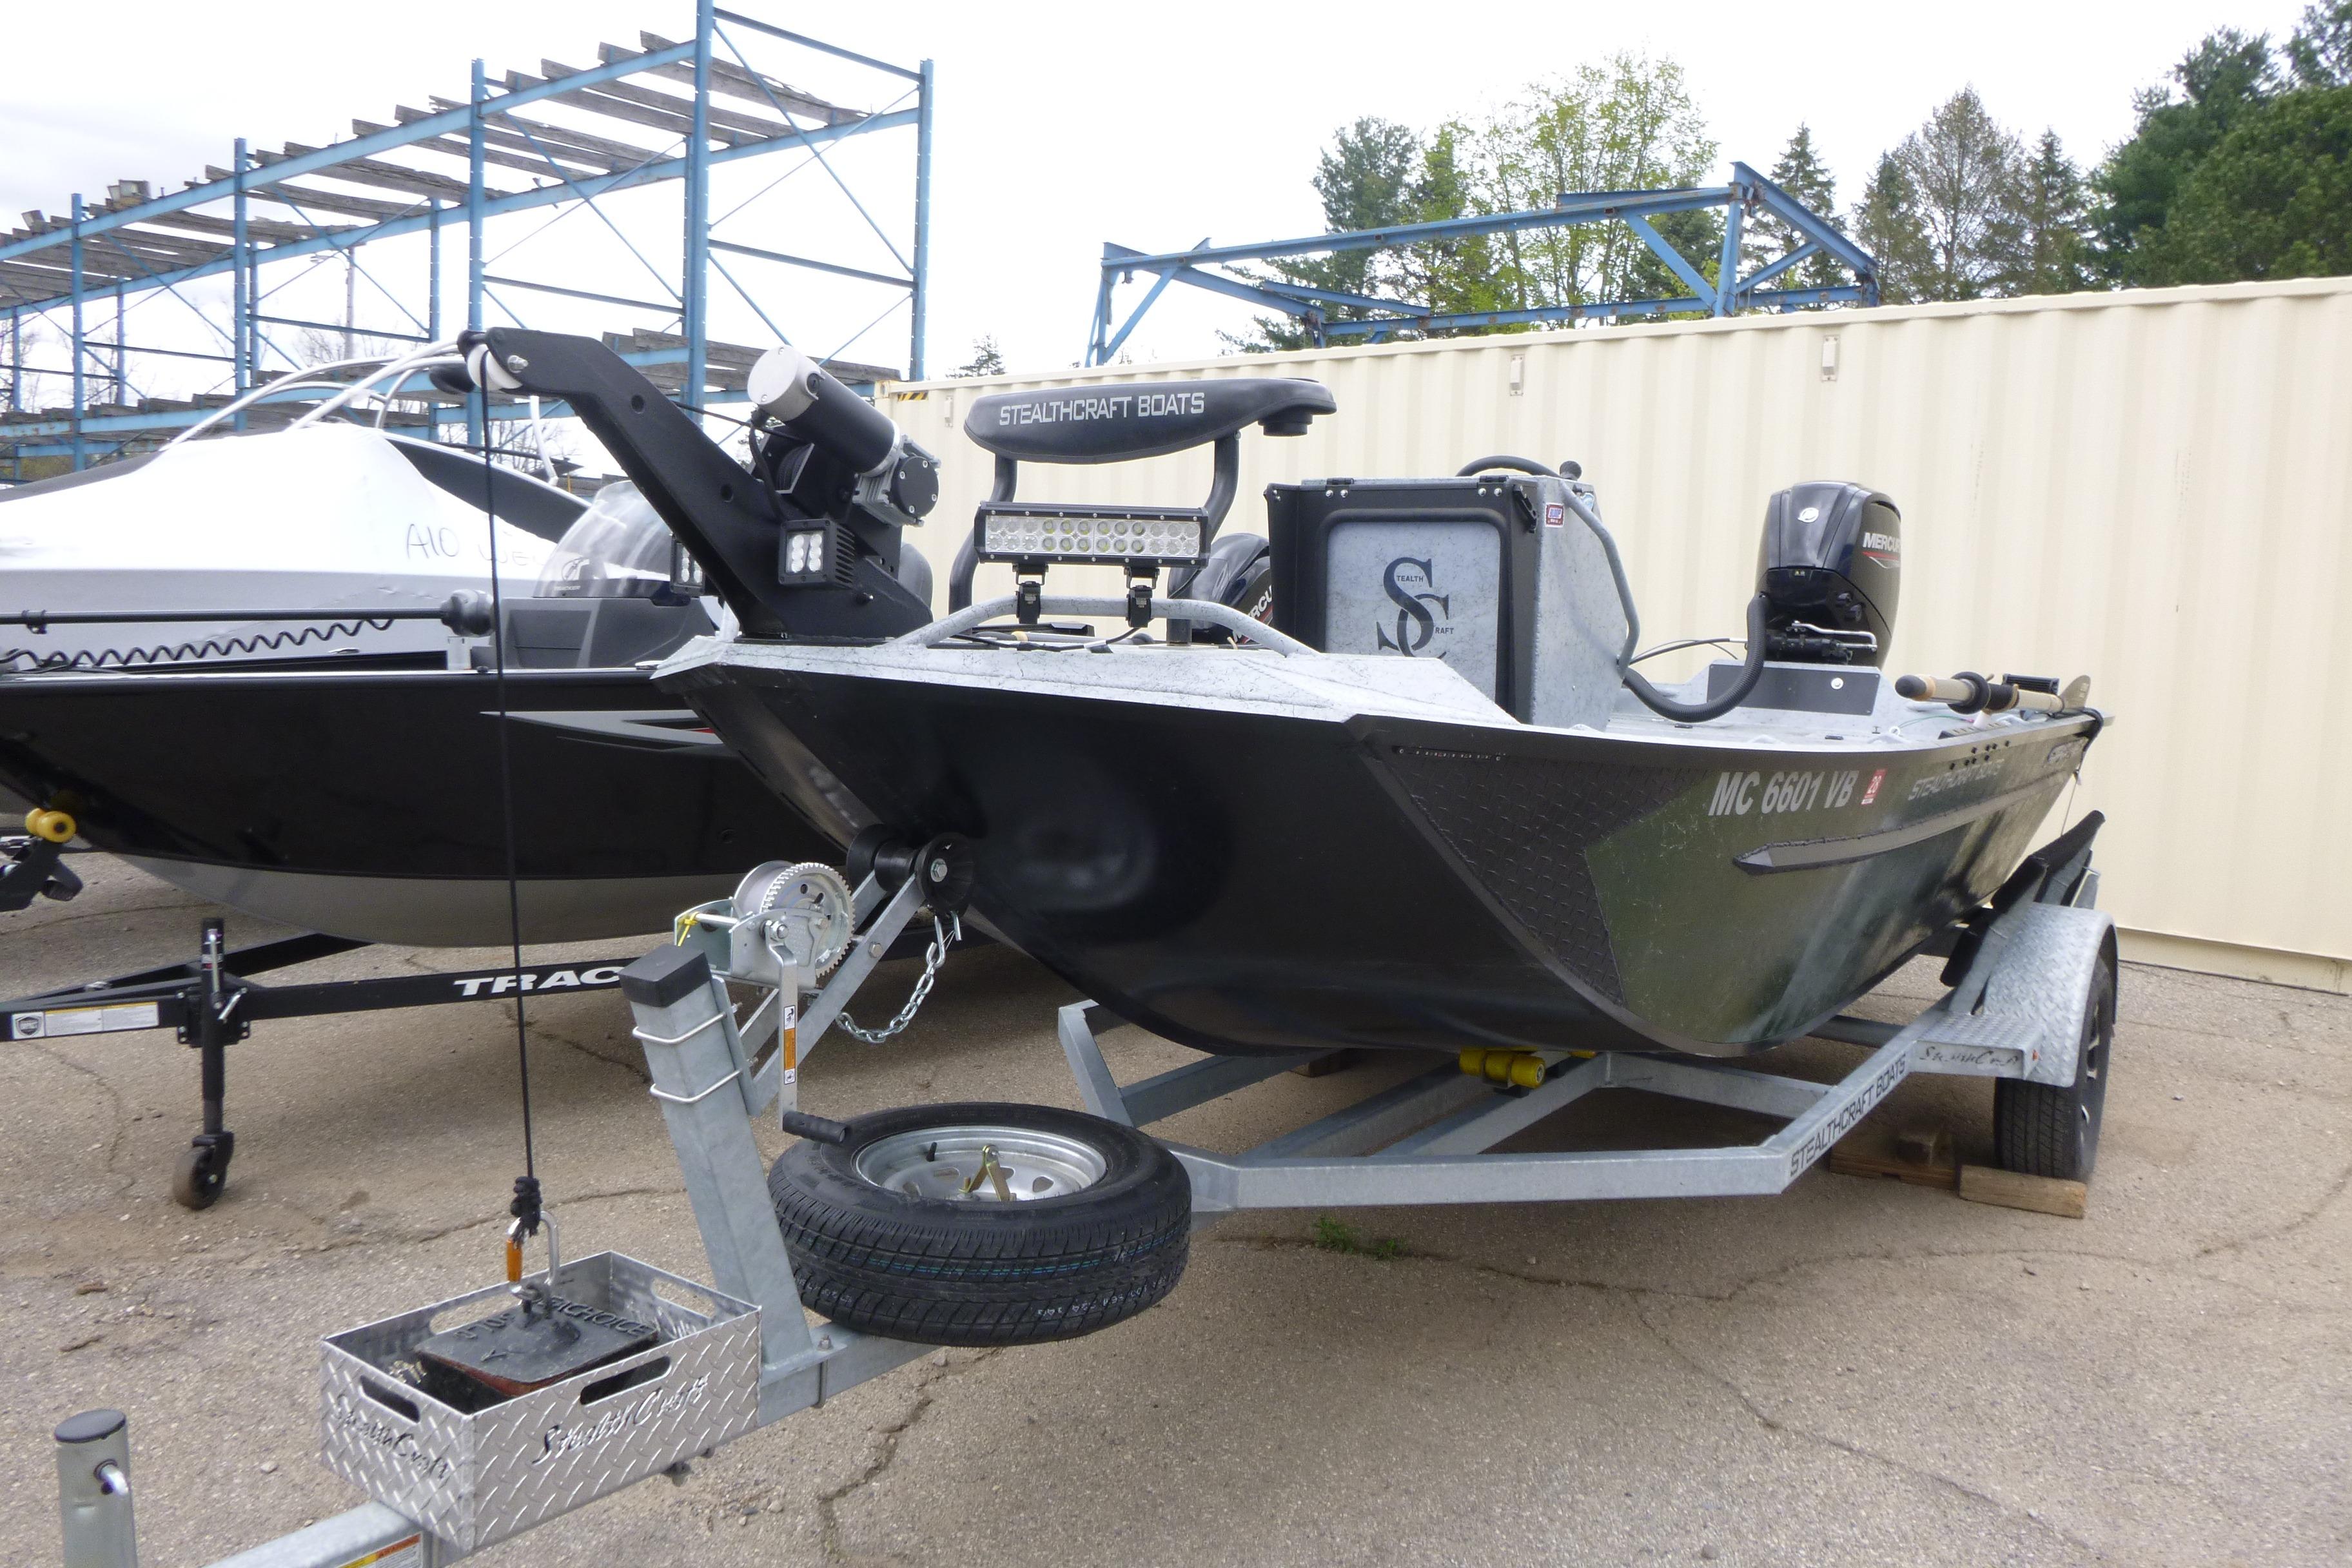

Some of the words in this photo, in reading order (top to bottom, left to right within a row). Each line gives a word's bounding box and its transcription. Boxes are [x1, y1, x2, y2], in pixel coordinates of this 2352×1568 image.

[999, 397, 1132, 426] STEALTHCRAFT
[1137, 393, 1204, 417] BOATS
[1709, 771, 1760, 816] MC
[1761, 771, 1825, 814] 6601
[1824, 770, 1859, 808] VB
[1790, 1084, 1874, 1177] STEALTHCRAFT
[1876, 1054, 1906, 1098] BOATS
